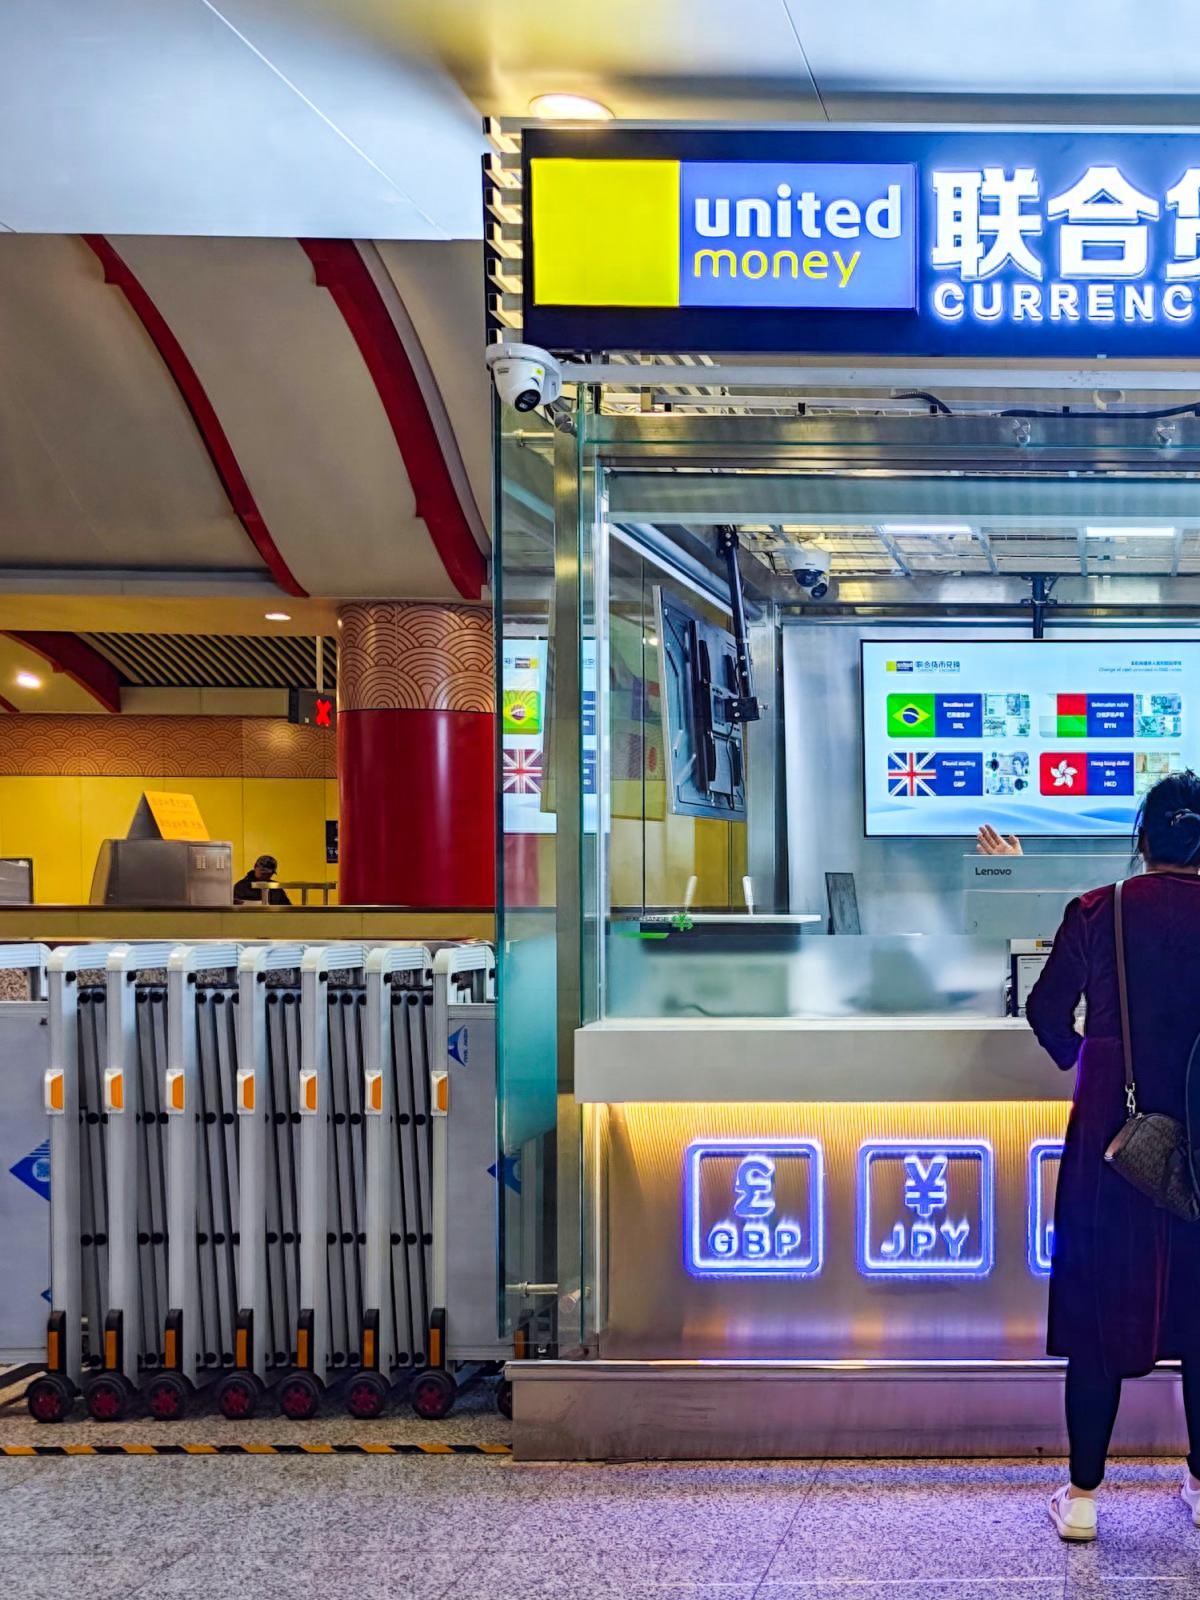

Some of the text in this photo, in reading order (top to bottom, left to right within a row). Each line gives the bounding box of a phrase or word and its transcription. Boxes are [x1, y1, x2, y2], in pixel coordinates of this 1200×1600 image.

[694, 183, 901, 239] united
[694, 248, 861, 288] money
[975, 867, 1011, 876] Lenovo
[707, 1224, 802, 1258] GBP
[880, 1223, 970, 1258] JPY
